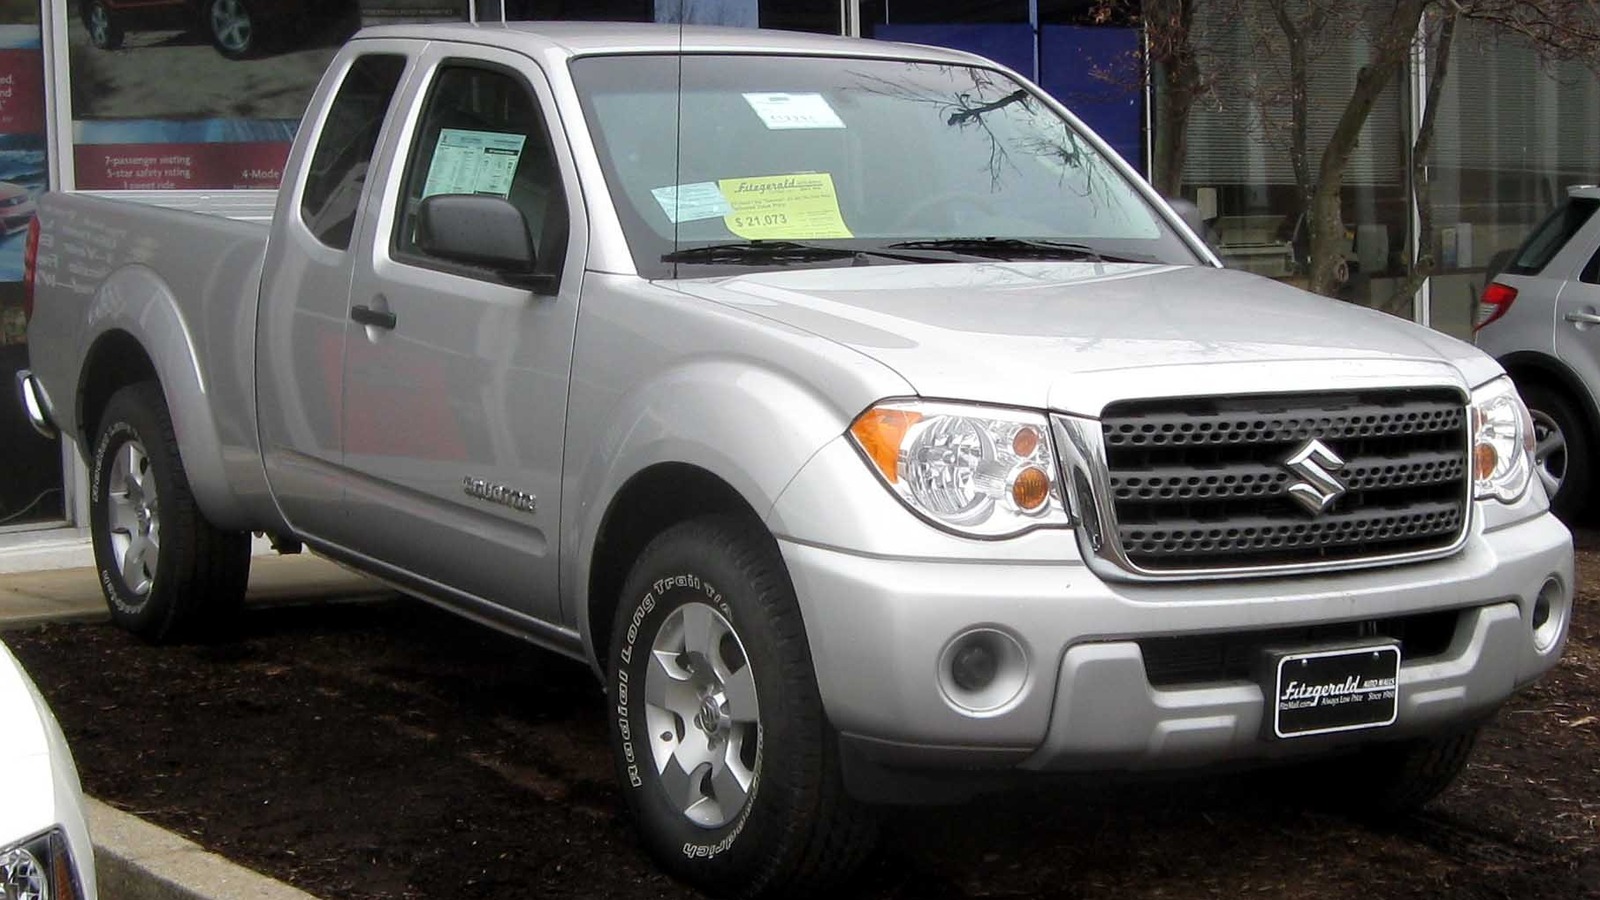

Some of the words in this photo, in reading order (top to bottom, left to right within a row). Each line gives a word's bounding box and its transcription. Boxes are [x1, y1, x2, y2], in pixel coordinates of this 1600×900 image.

[135, 168, 162, 178] safety
[242, 168, 280, 179] 4-Mode
[735, 178, 796, 194] Fitzgerald
[654, 573, 700, 595] Trail
[620, 592, 655, 665] Long
[1281, 675, 1360, 707] Fitzgerald
[1321, 696, 1340, 707] Always
[1340, 695, 1351, 704] Low
[1351, 693, 1364, 703] Price
[1368, 691, 1382, 701] Since
[617, 671, 642, 788] Radial
